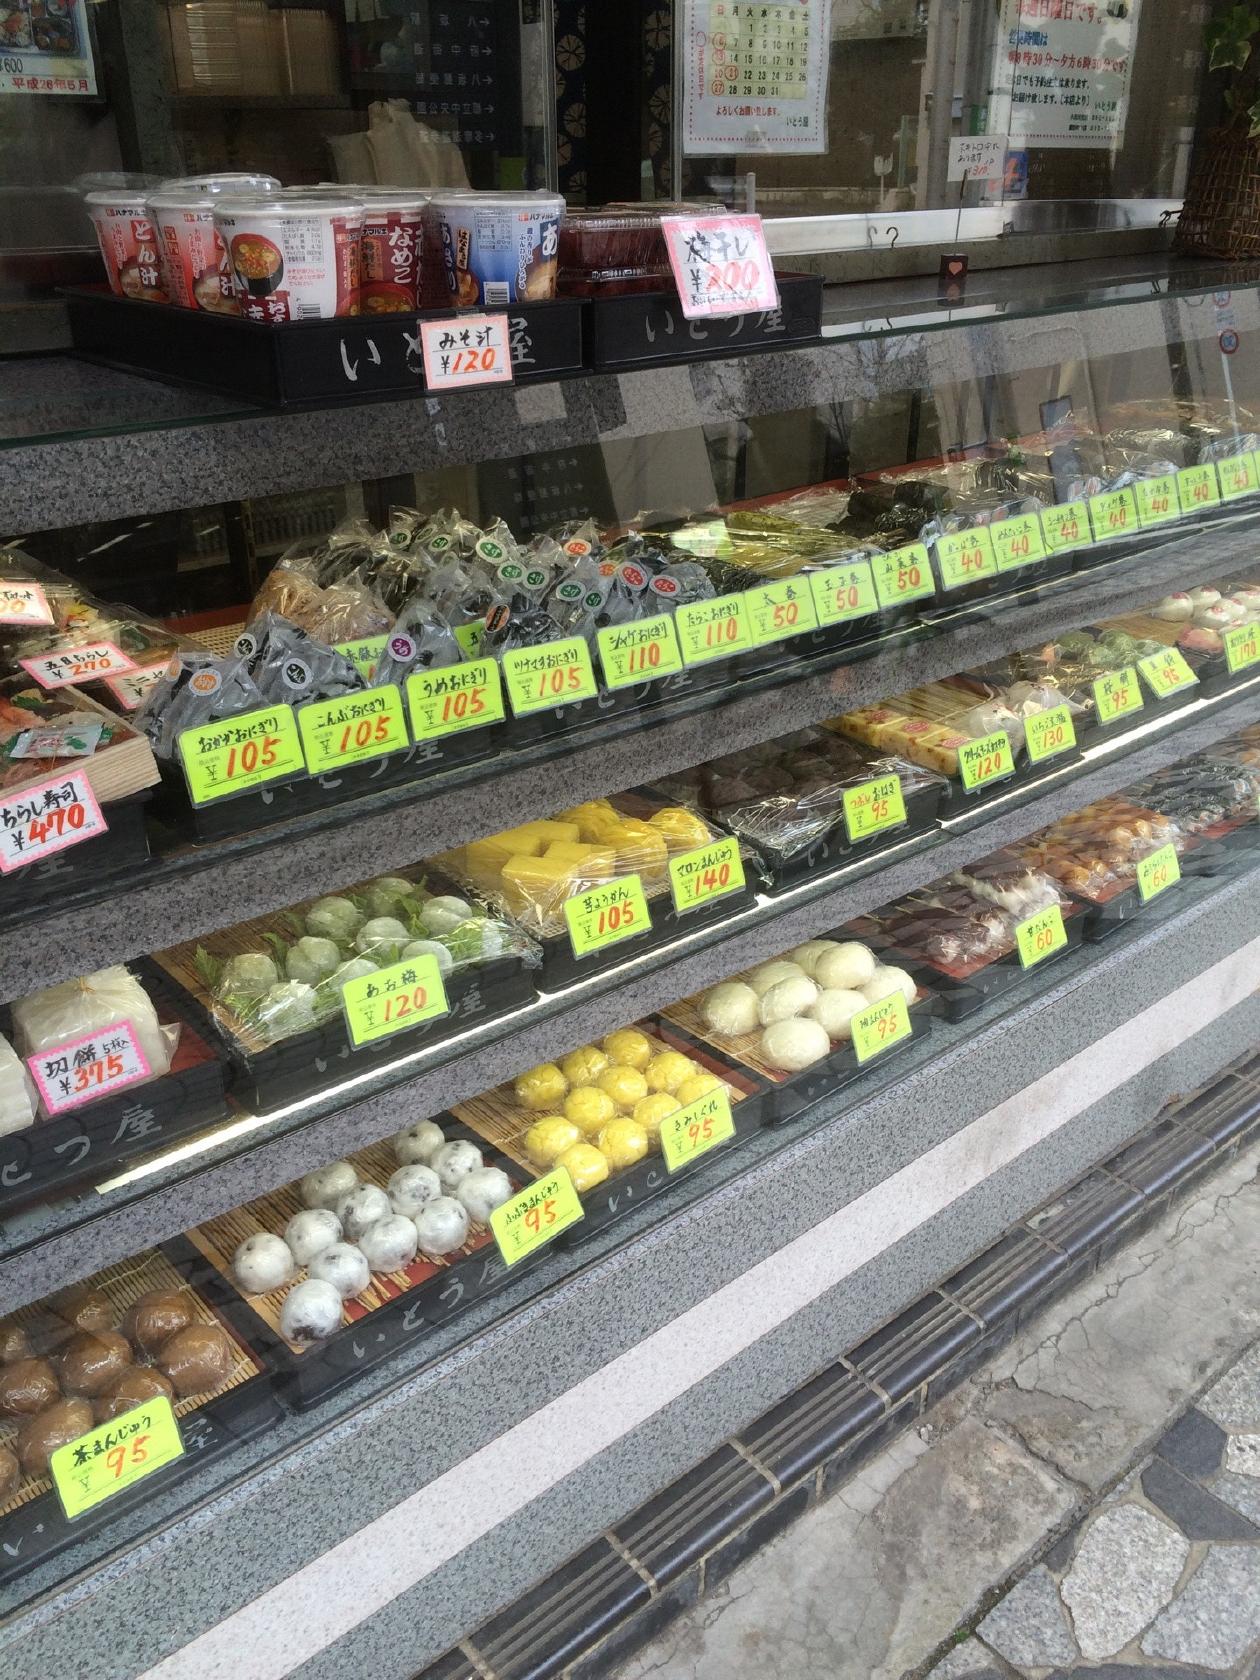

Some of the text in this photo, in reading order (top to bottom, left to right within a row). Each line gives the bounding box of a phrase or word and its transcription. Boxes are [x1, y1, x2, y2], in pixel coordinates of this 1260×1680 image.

[133, 220, 160, 286] とん汁
[388, 226, 414, 284] なめこ
[542, 223, 557, 255] あ
[439, 326, 493, 350] みそ汁
[441, 347, 496, 374] ¥120
[1151, 497, 1169, 513] 40
[1193, 482, 1209, 501] 40
[609, 621, 669, 651] シャケおにぎり
[44, 650, 109, 671] 五目ちらし
[52, 658, 112, 679] ¥270
[423, 667, 487, 698] うめおにぎり
[317, 697, 386, 729] こんぶおにぎり
[198, 717, 279, 754] おかかおにぎり
[1, 782, 78, 828] ちらし寿司
[12, 803, 85, 851] ¥470
[676, 845, 732, 878] マロンまんじゅう
[582, 886, 629, 914] 芋ようかん
[366, 968, 418, 998] あお梅
[45, 1044, 97, 1079] 切餅
[59, 1054, 125, 1095] ¥375
[72, 1415, 152, 1468] 茶まんじゅう
